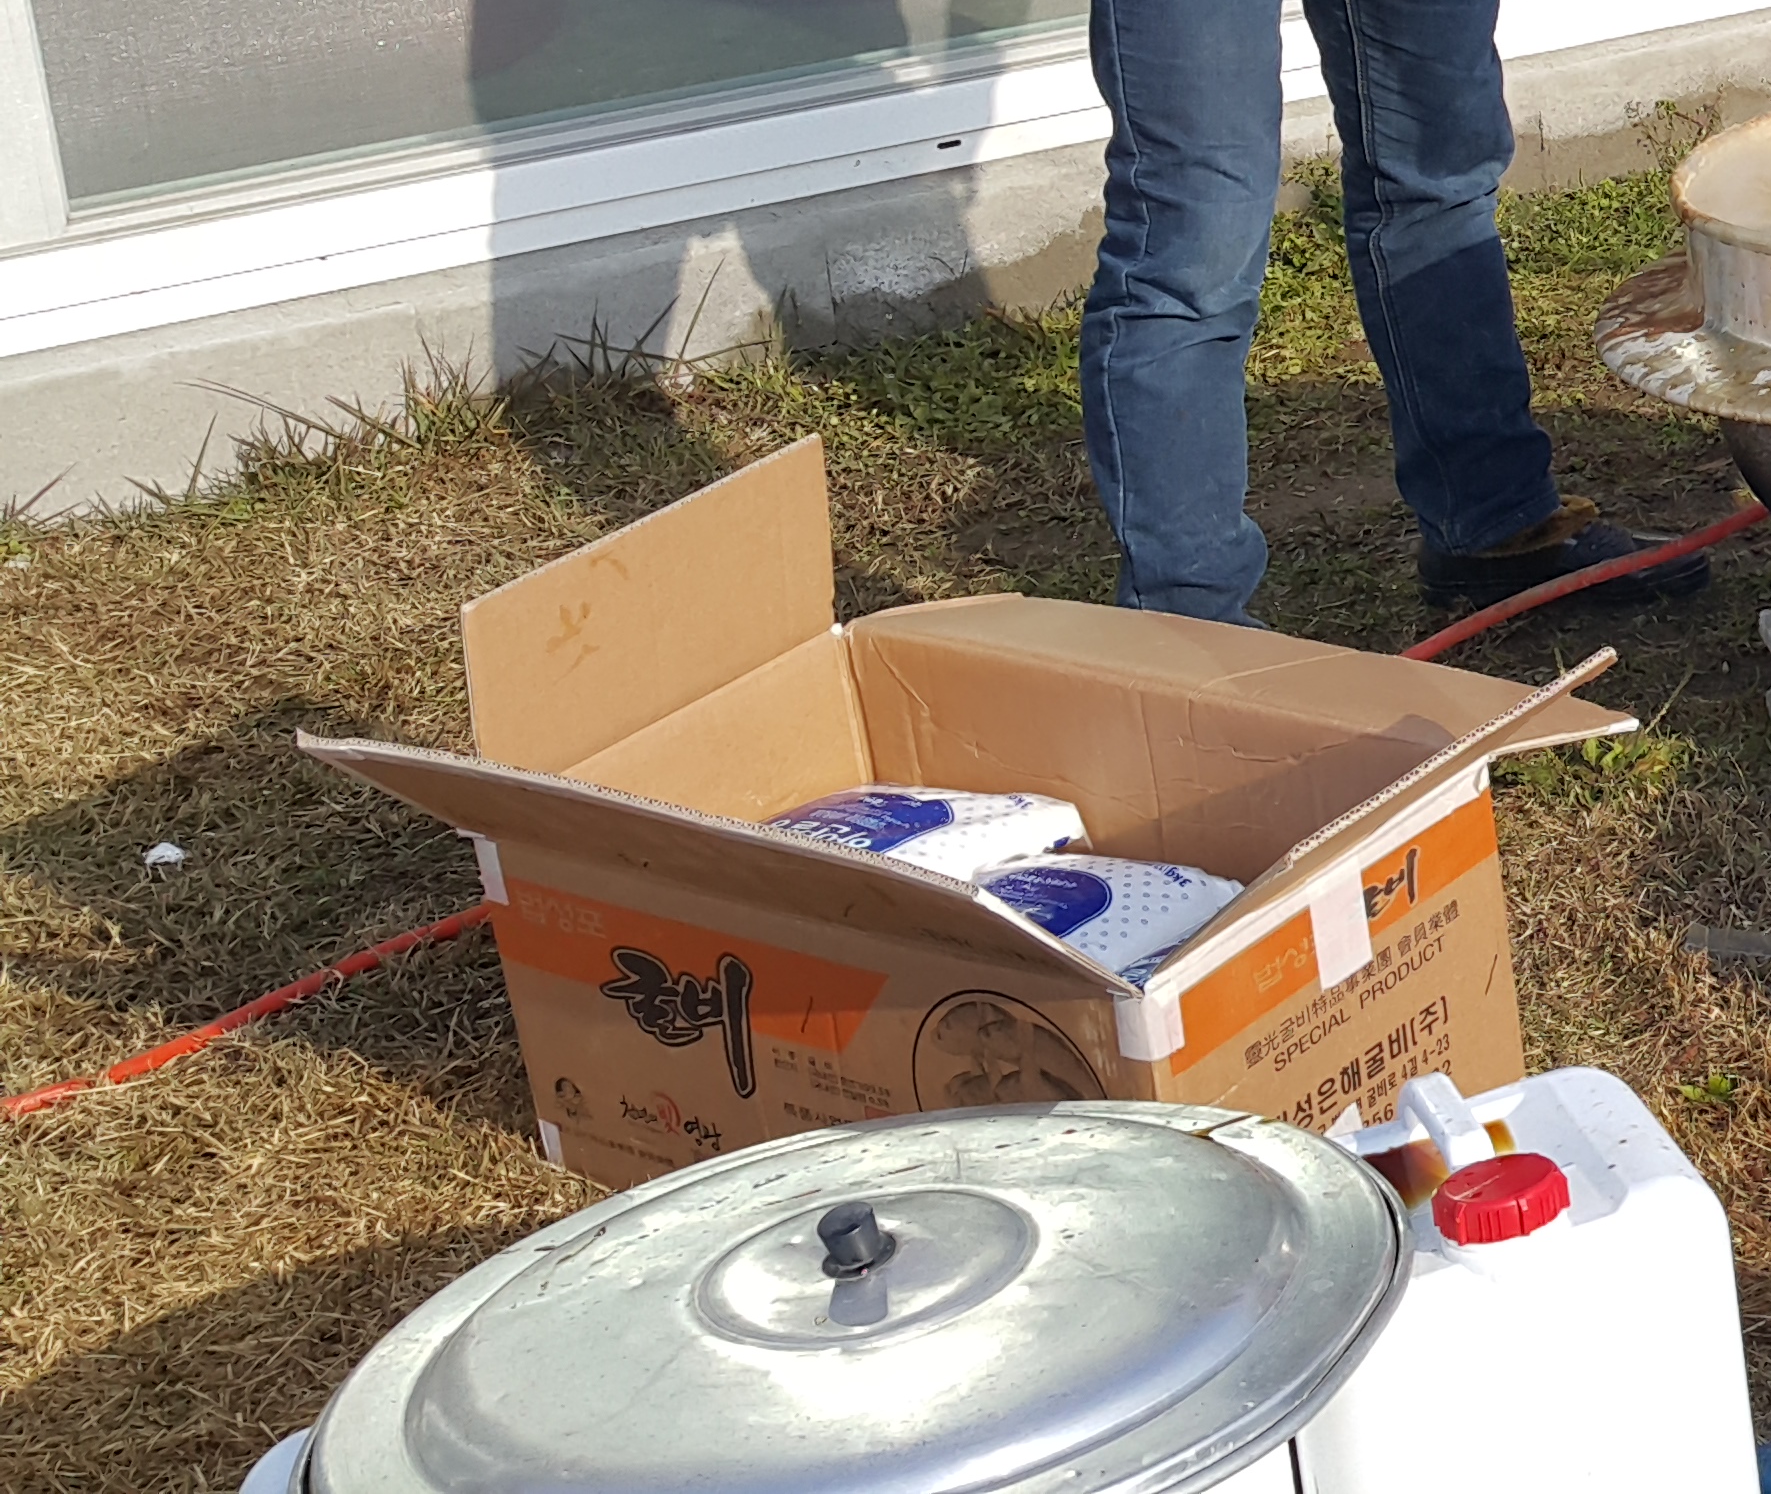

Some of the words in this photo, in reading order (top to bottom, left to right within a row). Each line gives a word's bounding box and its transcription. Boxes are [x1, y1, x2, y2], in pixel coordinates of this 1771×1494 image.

[1164, 866, 1193, 887] 3kg
[517, 889, 606, 938] 법성포
[1253, 935, 1317, 994] 법성
[600, 945, 757, 1098] 굴비
[1274, 1008, 1352, 1072] SPECIAL
[1359, 934, 1445, 1010] PRODUCT
[1366, 1071, 1398, 1108] 굴비로
[1401, 1054, 1418, 1081] 4길
[1421, 1033, 1450, 1065] 4-23
[684, 1116, 722, 1152] 영광
